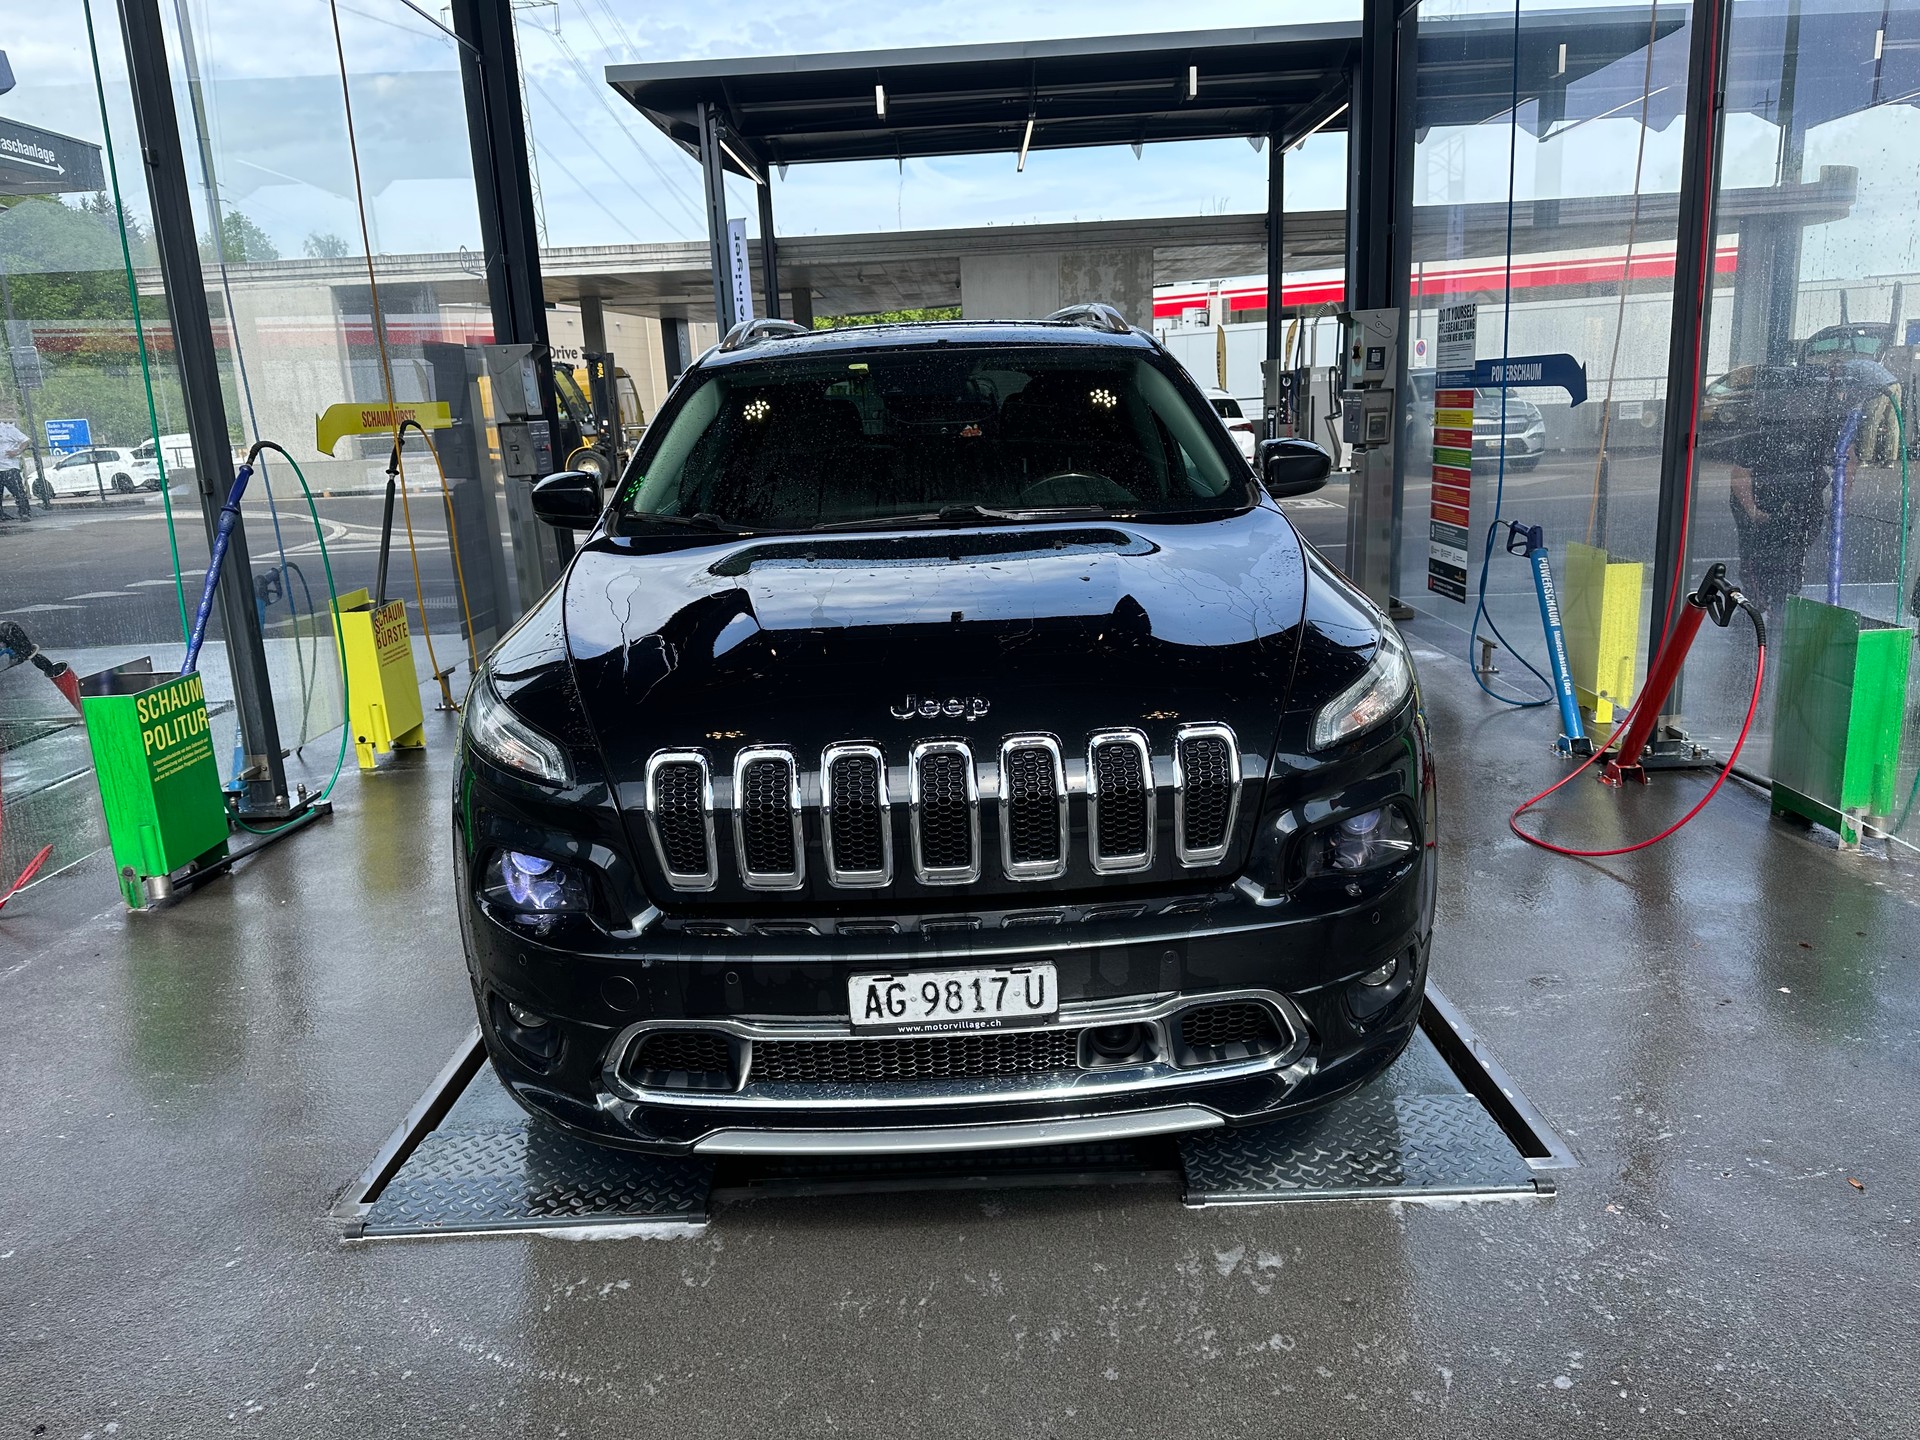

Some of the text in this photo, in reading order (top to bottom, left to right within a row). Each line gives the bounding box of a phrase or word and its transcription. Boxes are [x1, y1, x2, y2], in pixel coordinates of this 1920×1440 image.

[0, 137, 55, 163] aschanlage
[1451, 303, 1476, 320] YOURSELF
[550, 345, 578, 359] Drive
[361, 406, 416, 428] SCHAUMÜRSTE
[1538, 557, 1561, 627] POWERSCHAUM
[374, 602, 405, 635] SCHAUM
[376, 622, 408, 650] BÜRSTE
[137, 676, 204, 724] SCHAUM
[890, 694, 991, 721] Jeep
[143, 707, 209, 756] POLITUR
[865, 974, 1045, 1019] AG 9817 U
[897, 1020, 1002, 1034] www.motorvillage.ch
